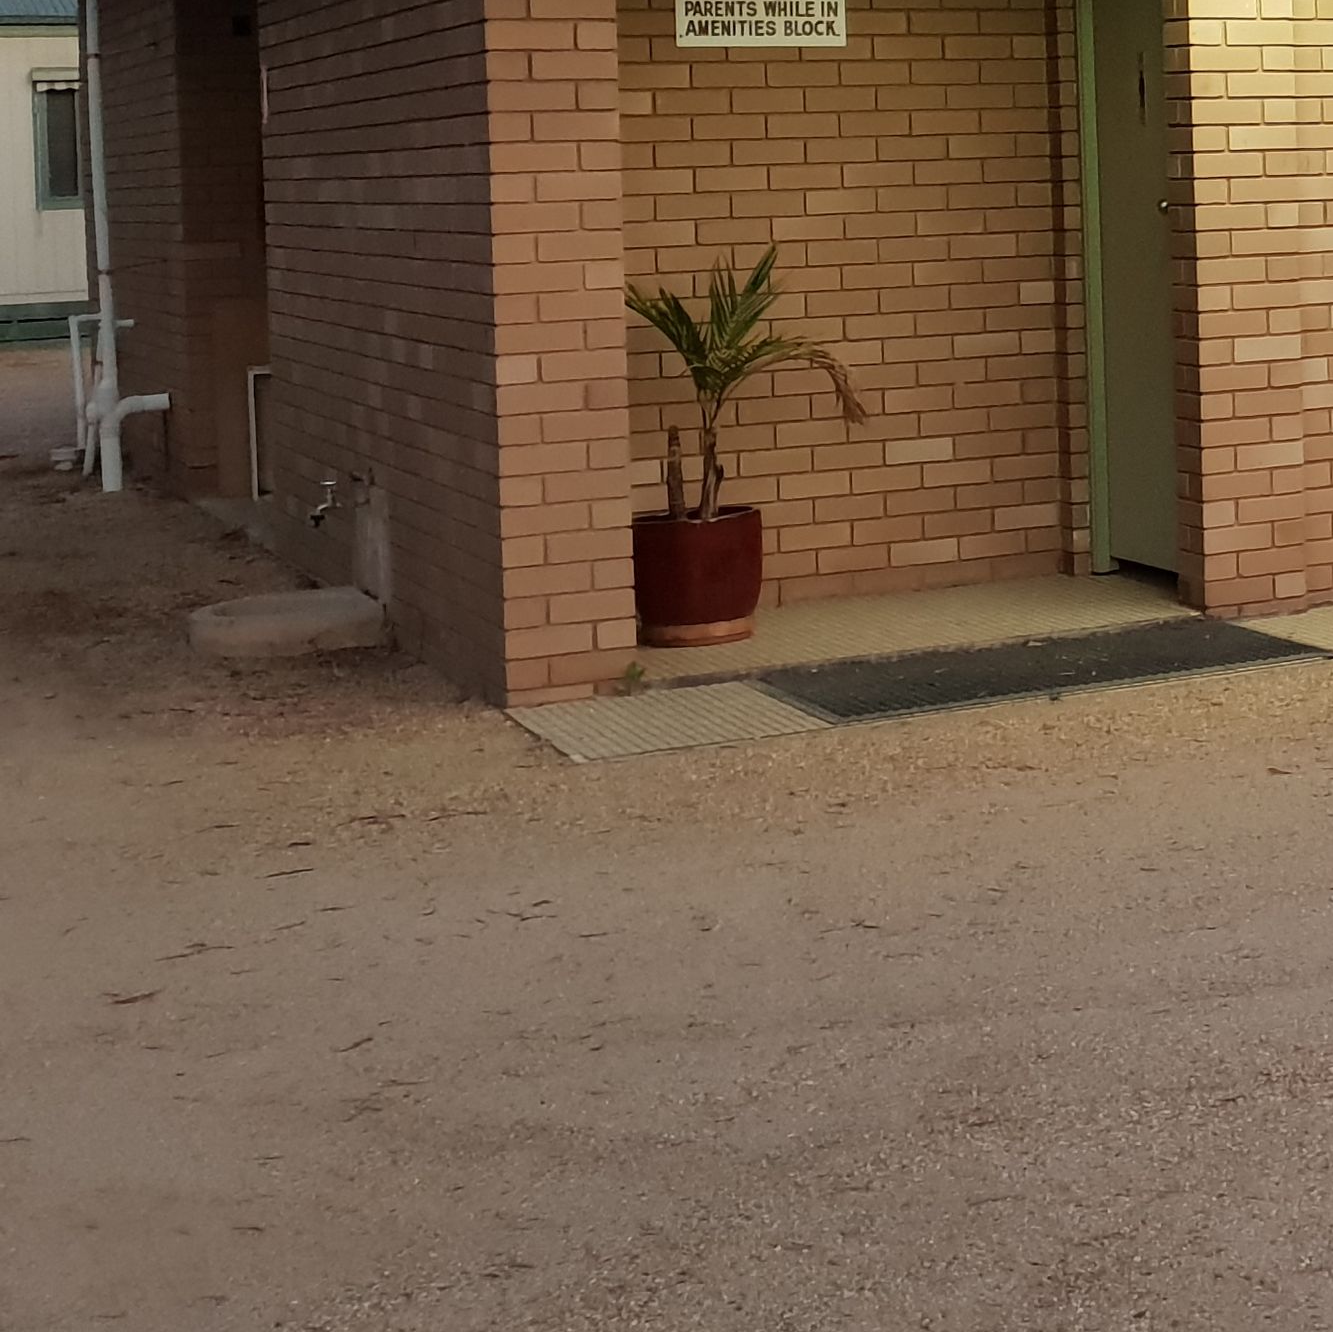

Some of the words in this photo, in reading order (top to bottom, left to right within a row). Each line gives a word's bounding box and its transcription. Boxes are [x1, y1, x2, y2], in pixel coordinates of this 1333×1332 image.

[684, 0, 757, 17] PARENTS
[763, 1, 815, 18] WHILE
[820, 1, 838, 17] IN
[685, 20, 777, 37] AMENITIES
